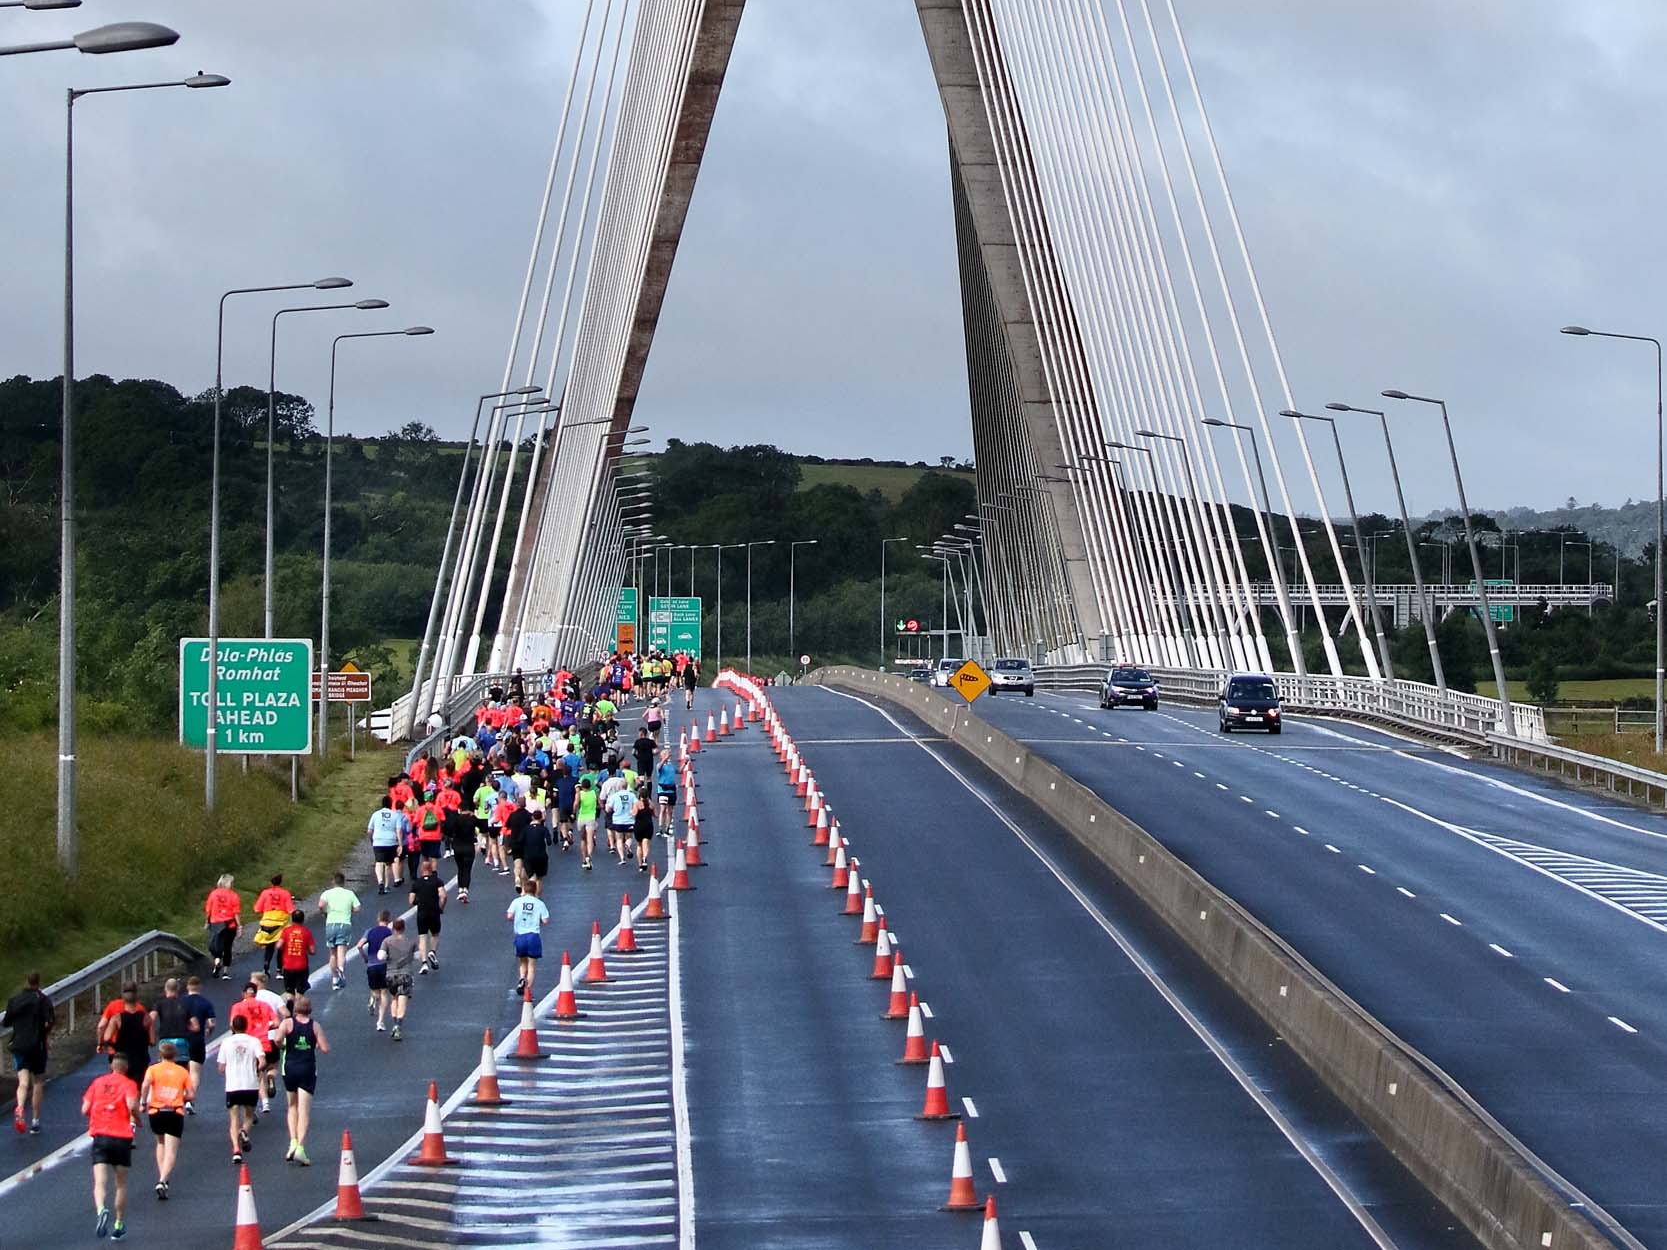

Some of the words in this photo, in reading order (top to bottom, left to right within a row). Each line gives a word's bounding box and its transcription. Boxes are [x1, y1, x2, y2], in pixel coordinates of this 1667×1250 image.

[216, 666, 281, 681] Romhat
[189, 692, 236, 707] TOLL
[242, 692, 301, 707] PLAZA
[216, 710, 278, 725] AHEAD
[225, 729, 232, 743] 1
[239, 729, 264, 743] km
[522, 902, 534, 911] 10
